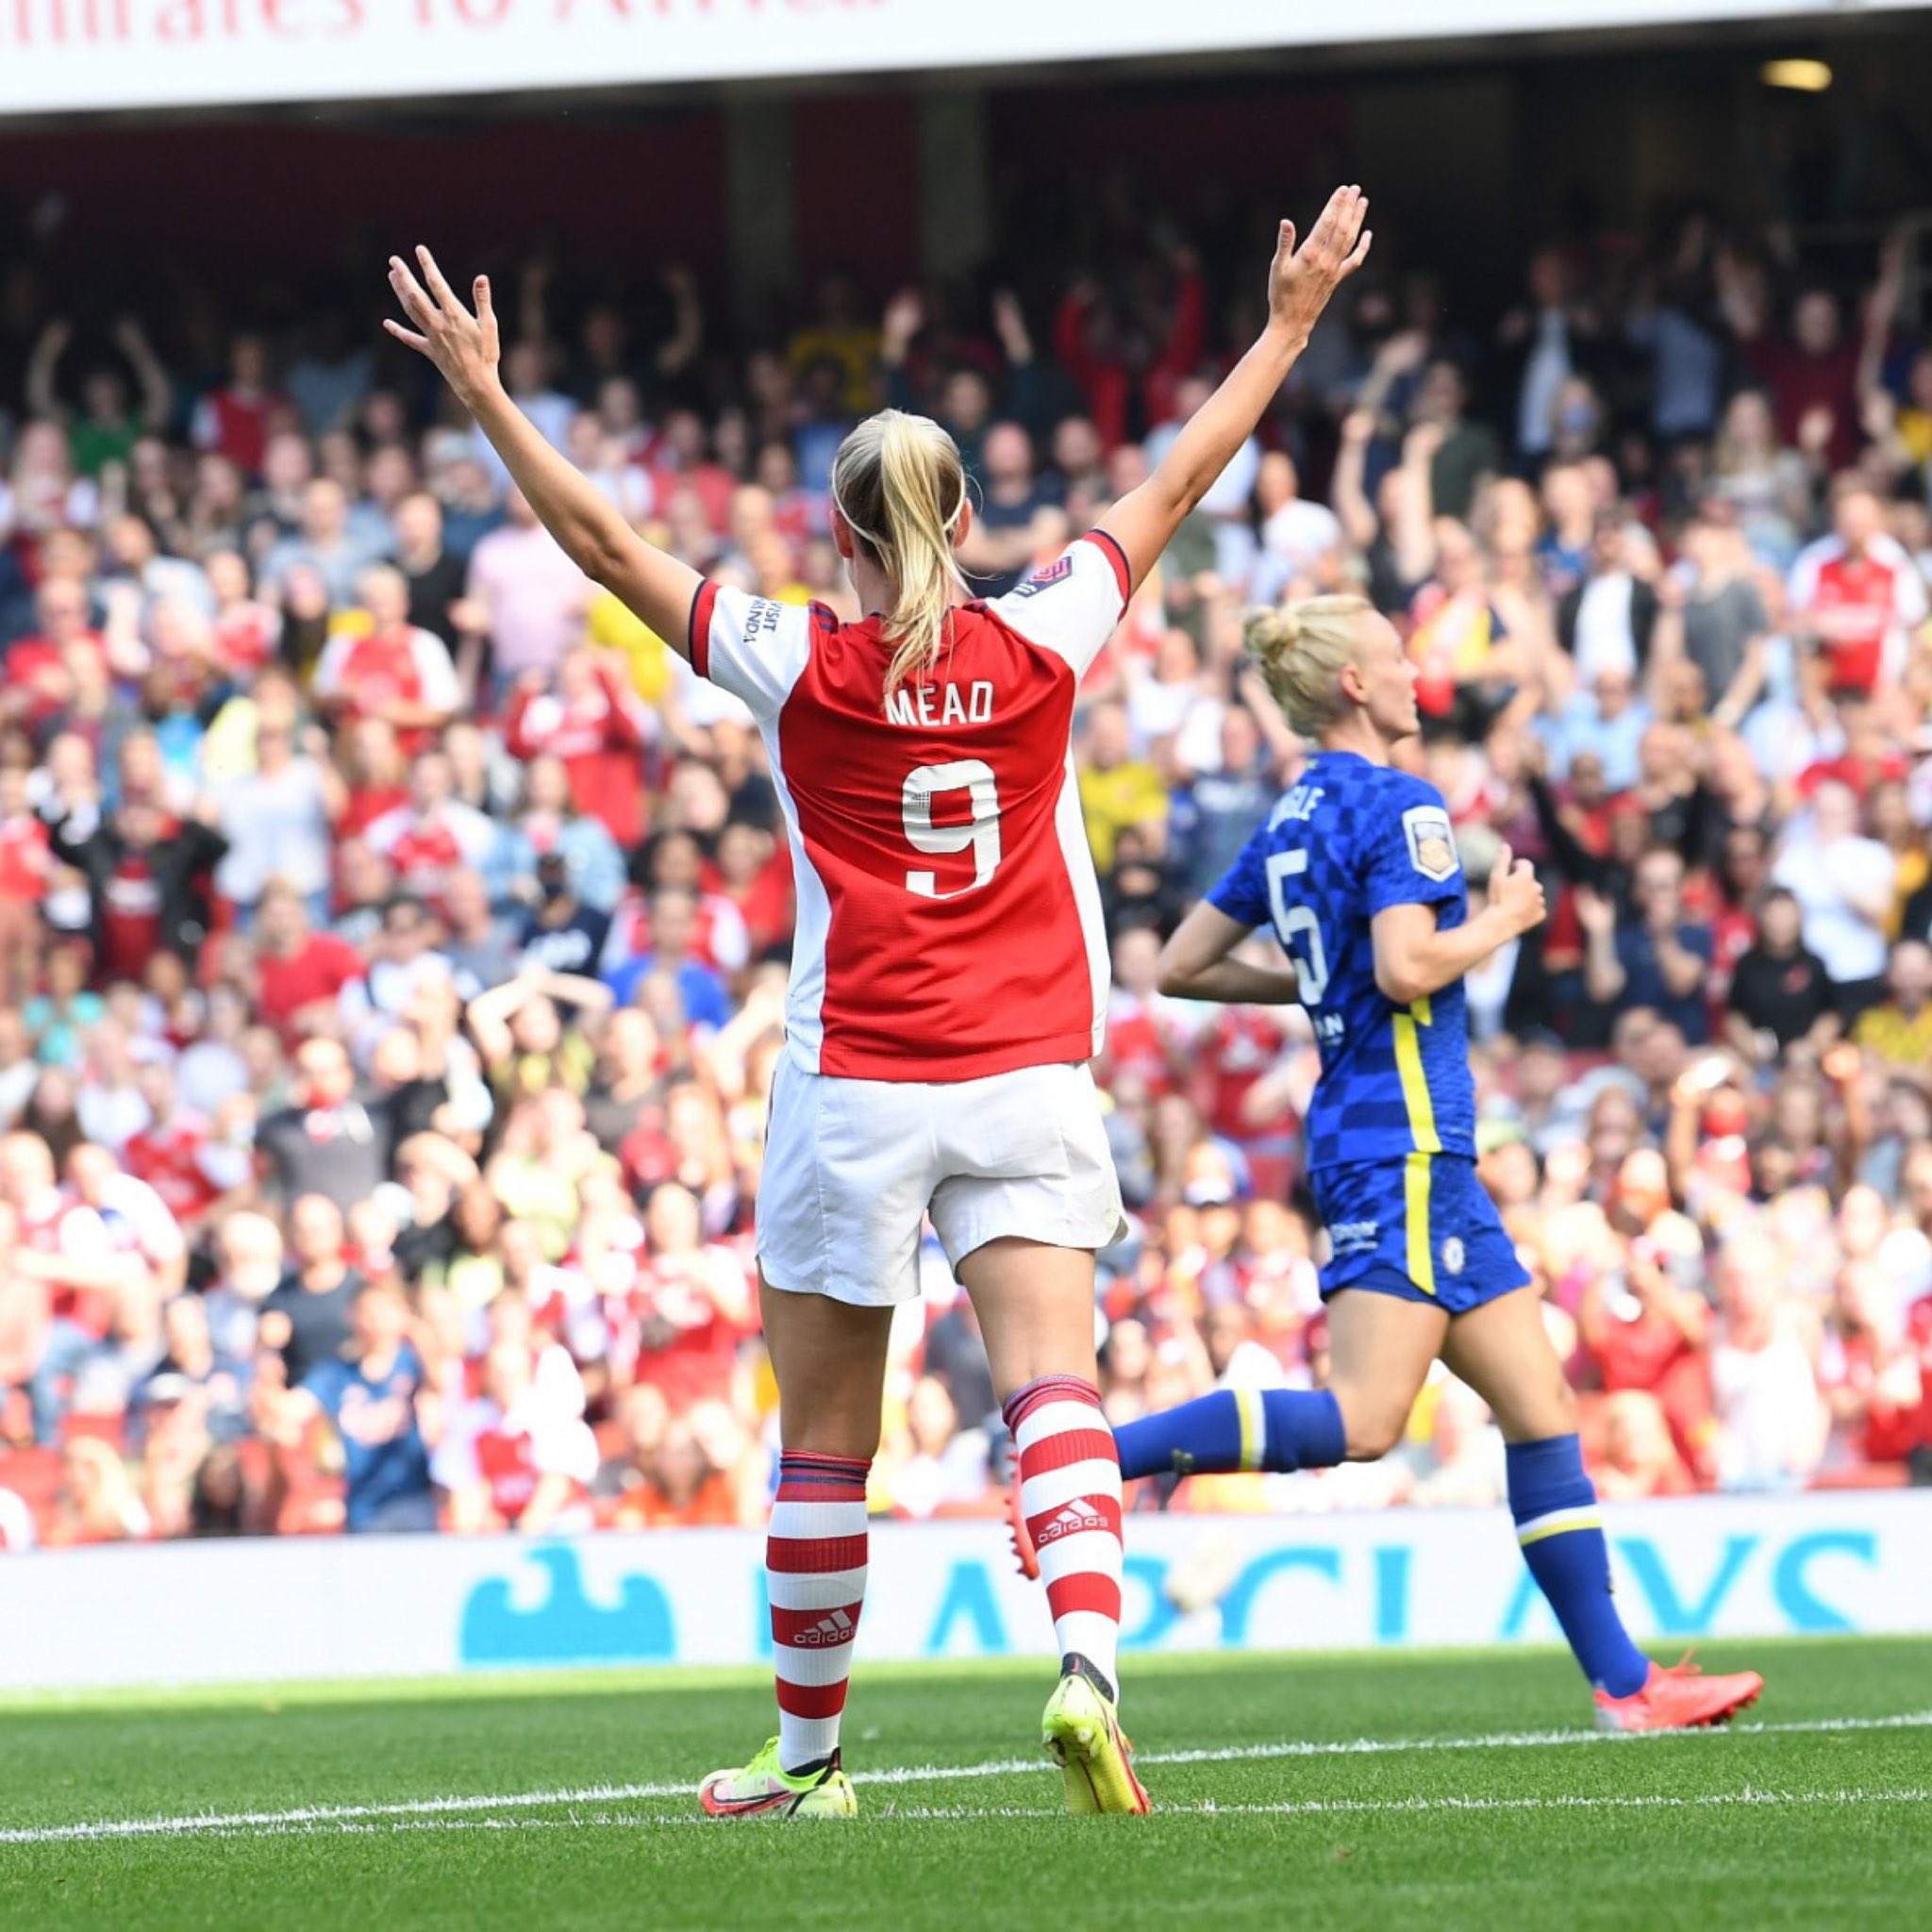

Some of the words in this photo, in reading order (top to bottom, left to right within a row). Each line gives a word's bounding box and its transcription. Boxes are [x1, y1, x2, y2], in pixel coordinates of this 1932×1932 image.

[884, 680, 994, 727] MEAD
[902, 758, 1002, 900] 9
[1266, 849, 1329, 1006] 5
[1038, 1515, 1109, 1544] adidas
